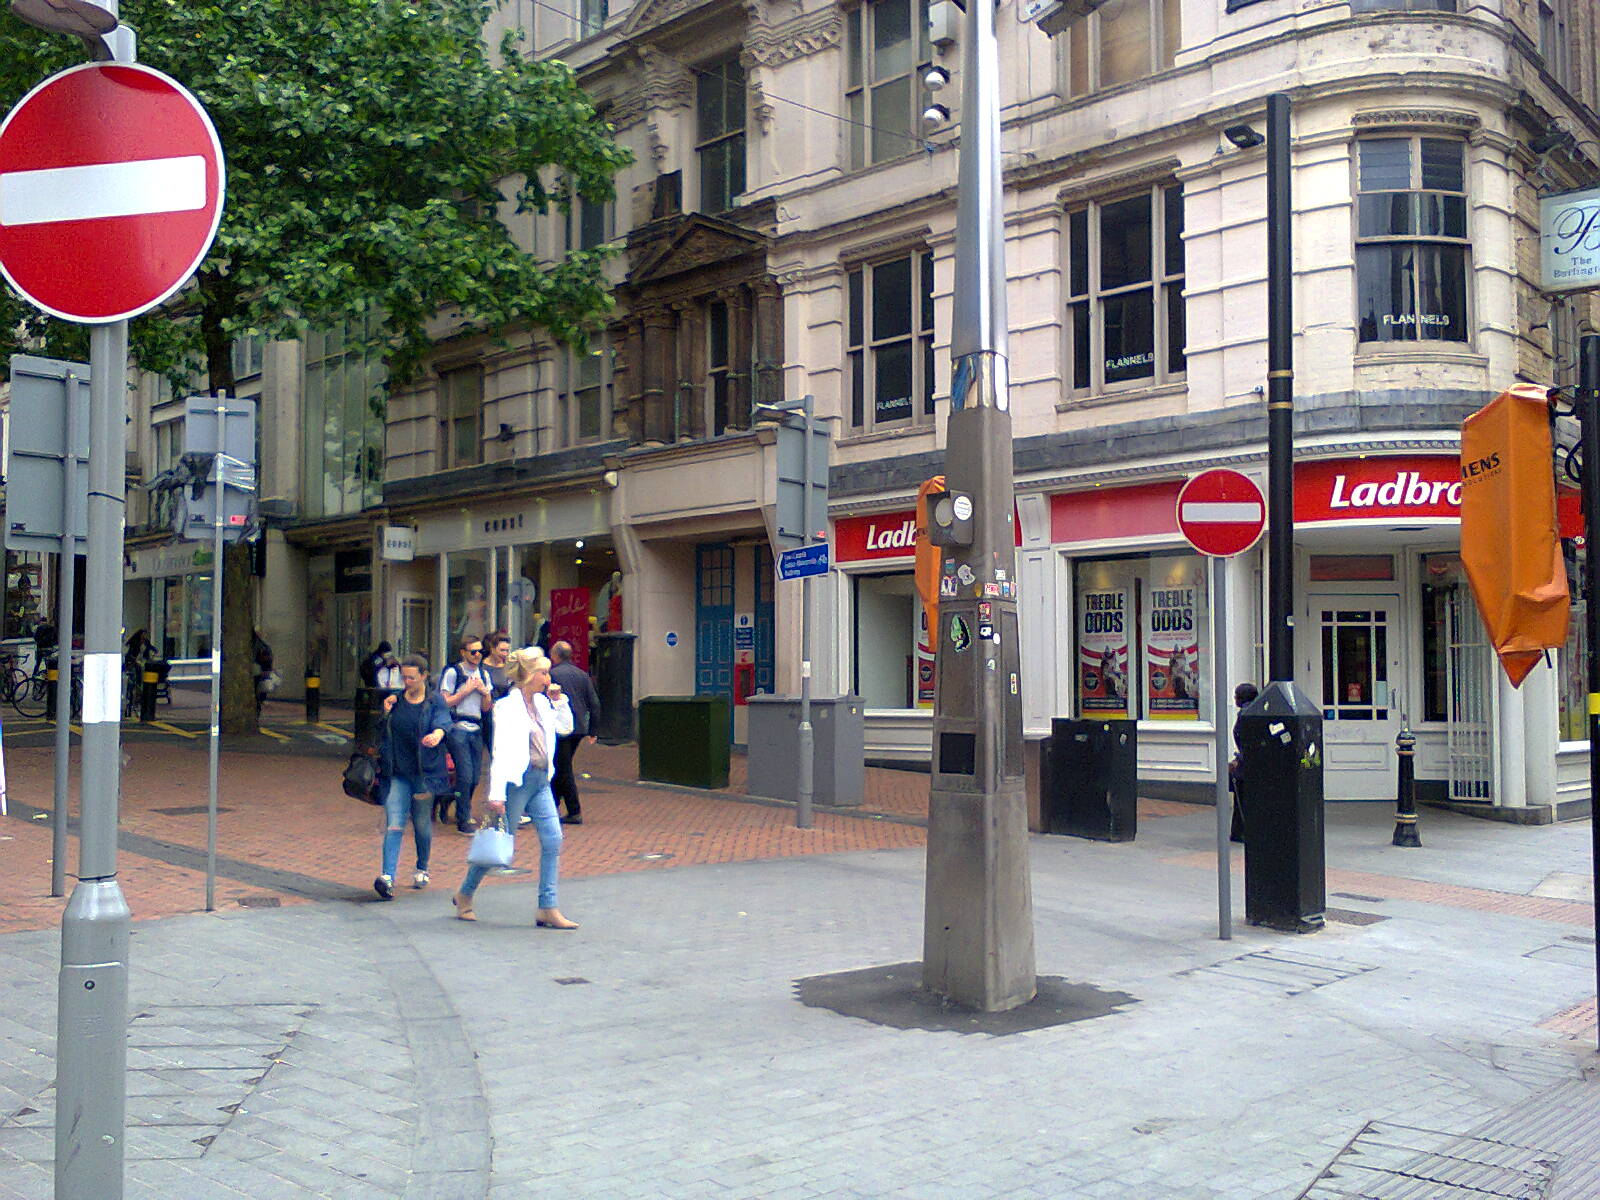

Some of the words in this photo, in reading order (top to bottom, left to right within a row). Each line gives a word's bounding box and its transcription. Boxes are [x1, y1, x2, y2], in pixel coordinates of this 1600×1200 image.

[1571, 256, 1592, 265] The
[1383, 313, 1450, 326] FLANNELS
[1105, 352, 1154, 369] FLANNELS
[866, 520, 917, 550] Ladb
[1085, 593, 1124, 611] TREBLE
[1152, 589, 1193, 609] TREBLE
[1084, 611, 1124, 633] ODDS
[1151, 608, 1193, 632] ODDS
